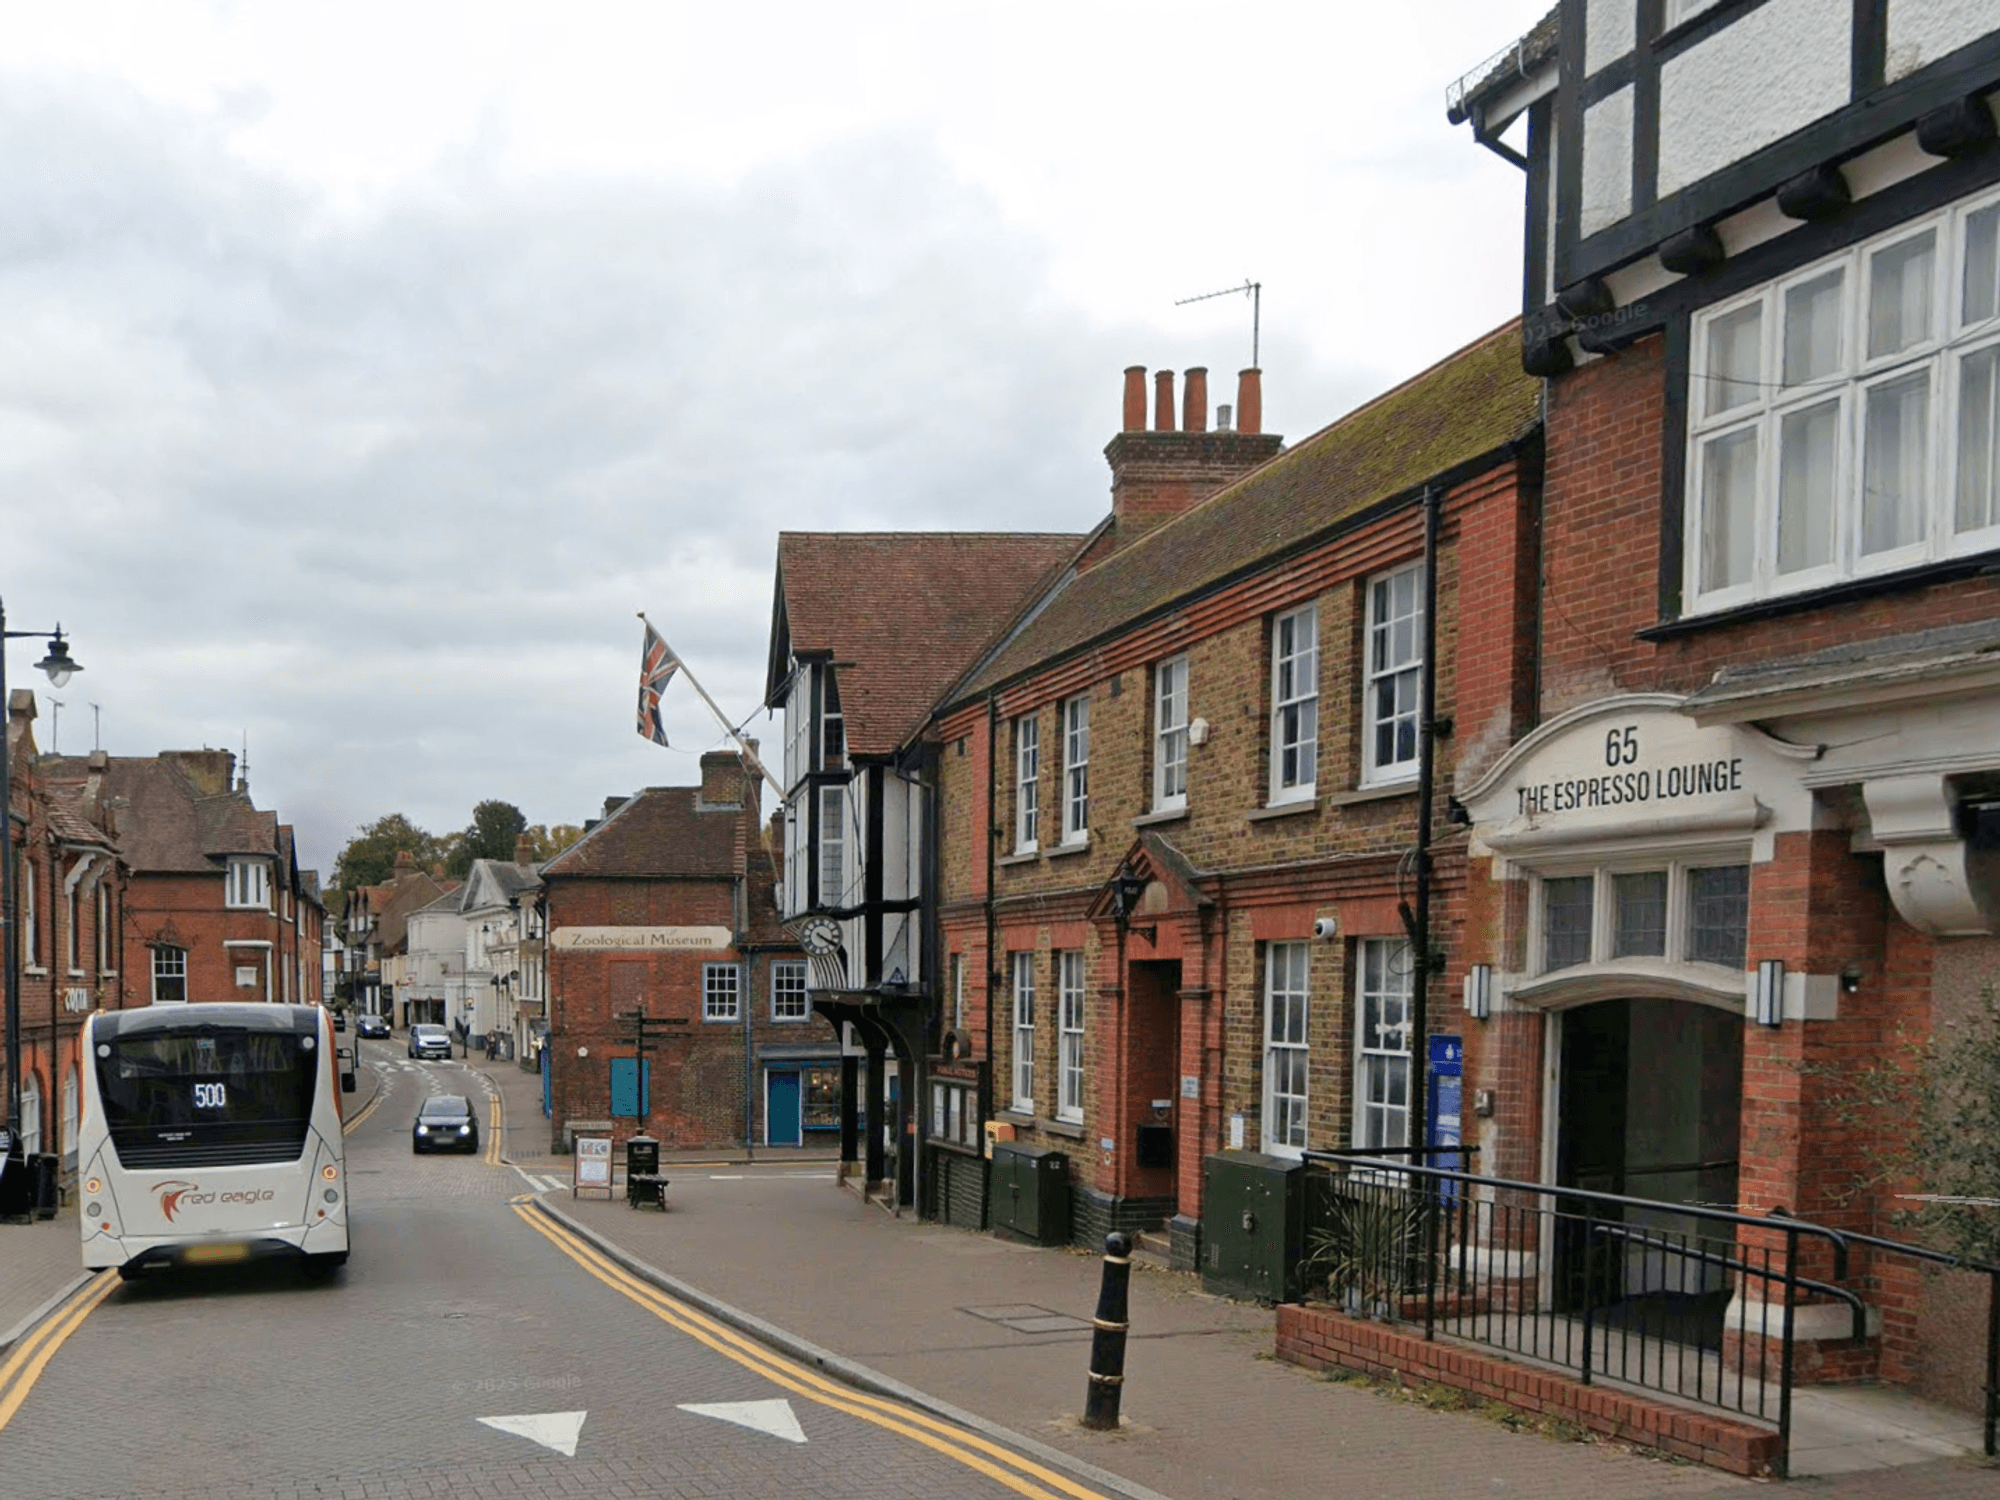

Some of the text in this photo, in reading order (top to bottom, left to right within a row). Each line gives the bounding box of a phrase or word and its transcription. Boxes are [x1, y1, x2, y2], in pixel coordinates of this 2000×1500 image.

[1606, 726, 1638, 767] 65
[1518, 758, 1742, 815] THE ESPRESSO LOUNGE
[572, 932, 712, 948] Zoological Museum
[194, 1082, 226, 1108] 500
[181, 1188, 274, 1205] red eagle
